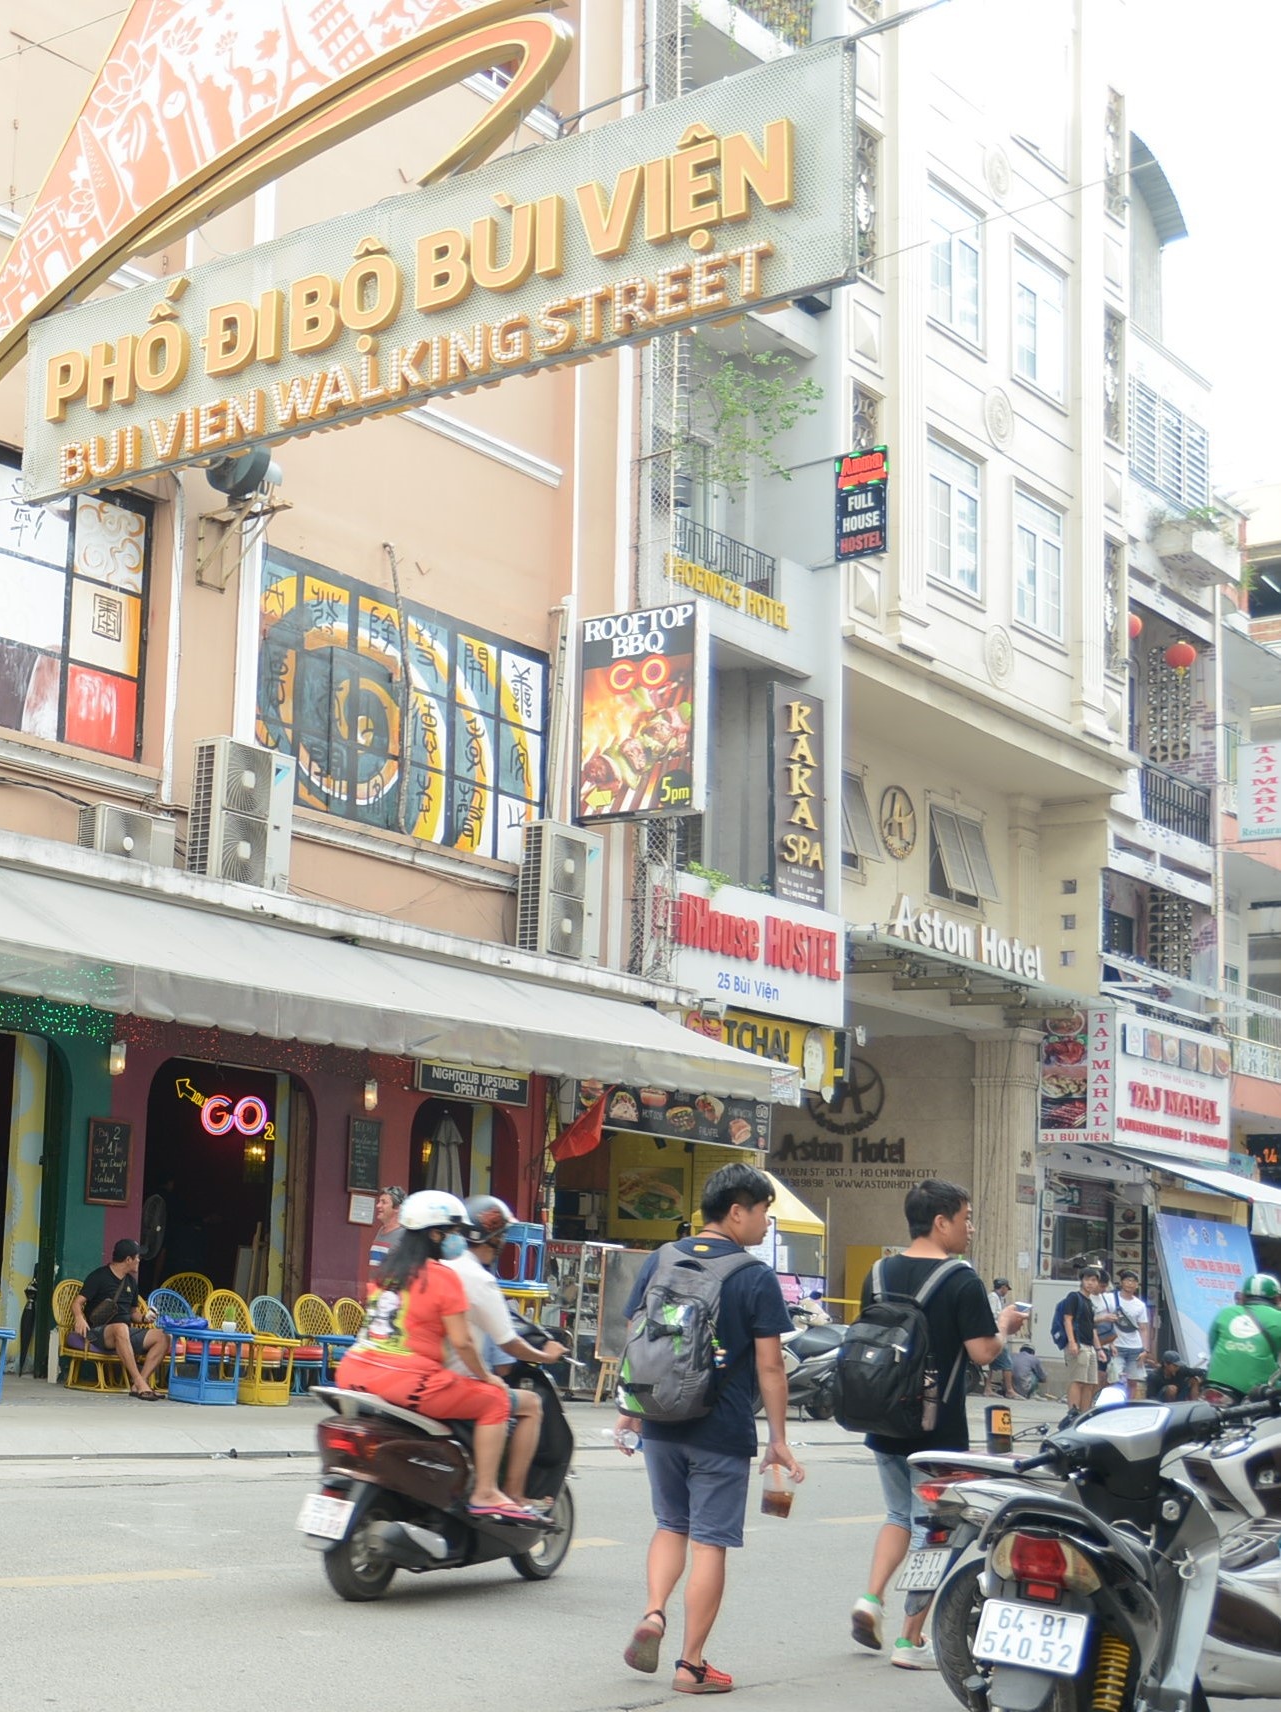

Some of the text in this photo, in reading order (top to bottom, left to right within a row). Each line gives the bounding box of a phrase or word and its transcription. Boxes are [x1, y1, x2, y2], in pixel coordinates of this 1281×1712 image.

[44, 118, 797, 424] PHỐ ĐI BỘ BÙI VIỆN
[57, 241, 775, 490] BUI VIEN WALKING STREET
[847, 491, 875, 512] FULL
[842, 511, 880, 533] HOUSE
[840, 530, 882, 553] HOSTEL
[584, 604, 694, 642] ROOFTOP
[745, 588, 790, 631] HOTEL
[611, 630, 664, 659] BBQ
[1251, 745, 1278, 774] TAJ
[660, 776, 690, 805] 5pm
[1251, 776, 1279, 824] MAHAL
[780, 833, 824, 872] SPA
[763, 914, 841, 981] HOSTEL
[891, 893, 1045, 982] Aston Hotel
[717, 971, 780, 1003] 25 Bùi Viện
[1094, 1013, 1110, 1052] TAJ
[432, 1066, 519, 1091] NIGHTCLUB UPSTAIRS
[453, 1082, 499, 1100] OPEN LATE
[1091, 1060, 1111, 1127] MAHAL
[200, 1094, 275, 1140] GO 2
[1128, 1081, 1162, 1112] TAJ
[1164, 1089, 1221, 1125] MAHAL
[113, 1126, 121, 1140] 2
[772, 1133, 906, 1164] Aston Hotel
[1042, 1133, 1055, 1142] 31
[875, 1168, 889, 1177] CHI
[890, 1168, 915, 1177] MINH
[917, 1169, 938, 1178] CITY
[910, 1552, 943, 1571] 59-T1
[998, 1606, 1067, 1640] 64-B1
[982, 1630, 1073, 1669] 540.52
